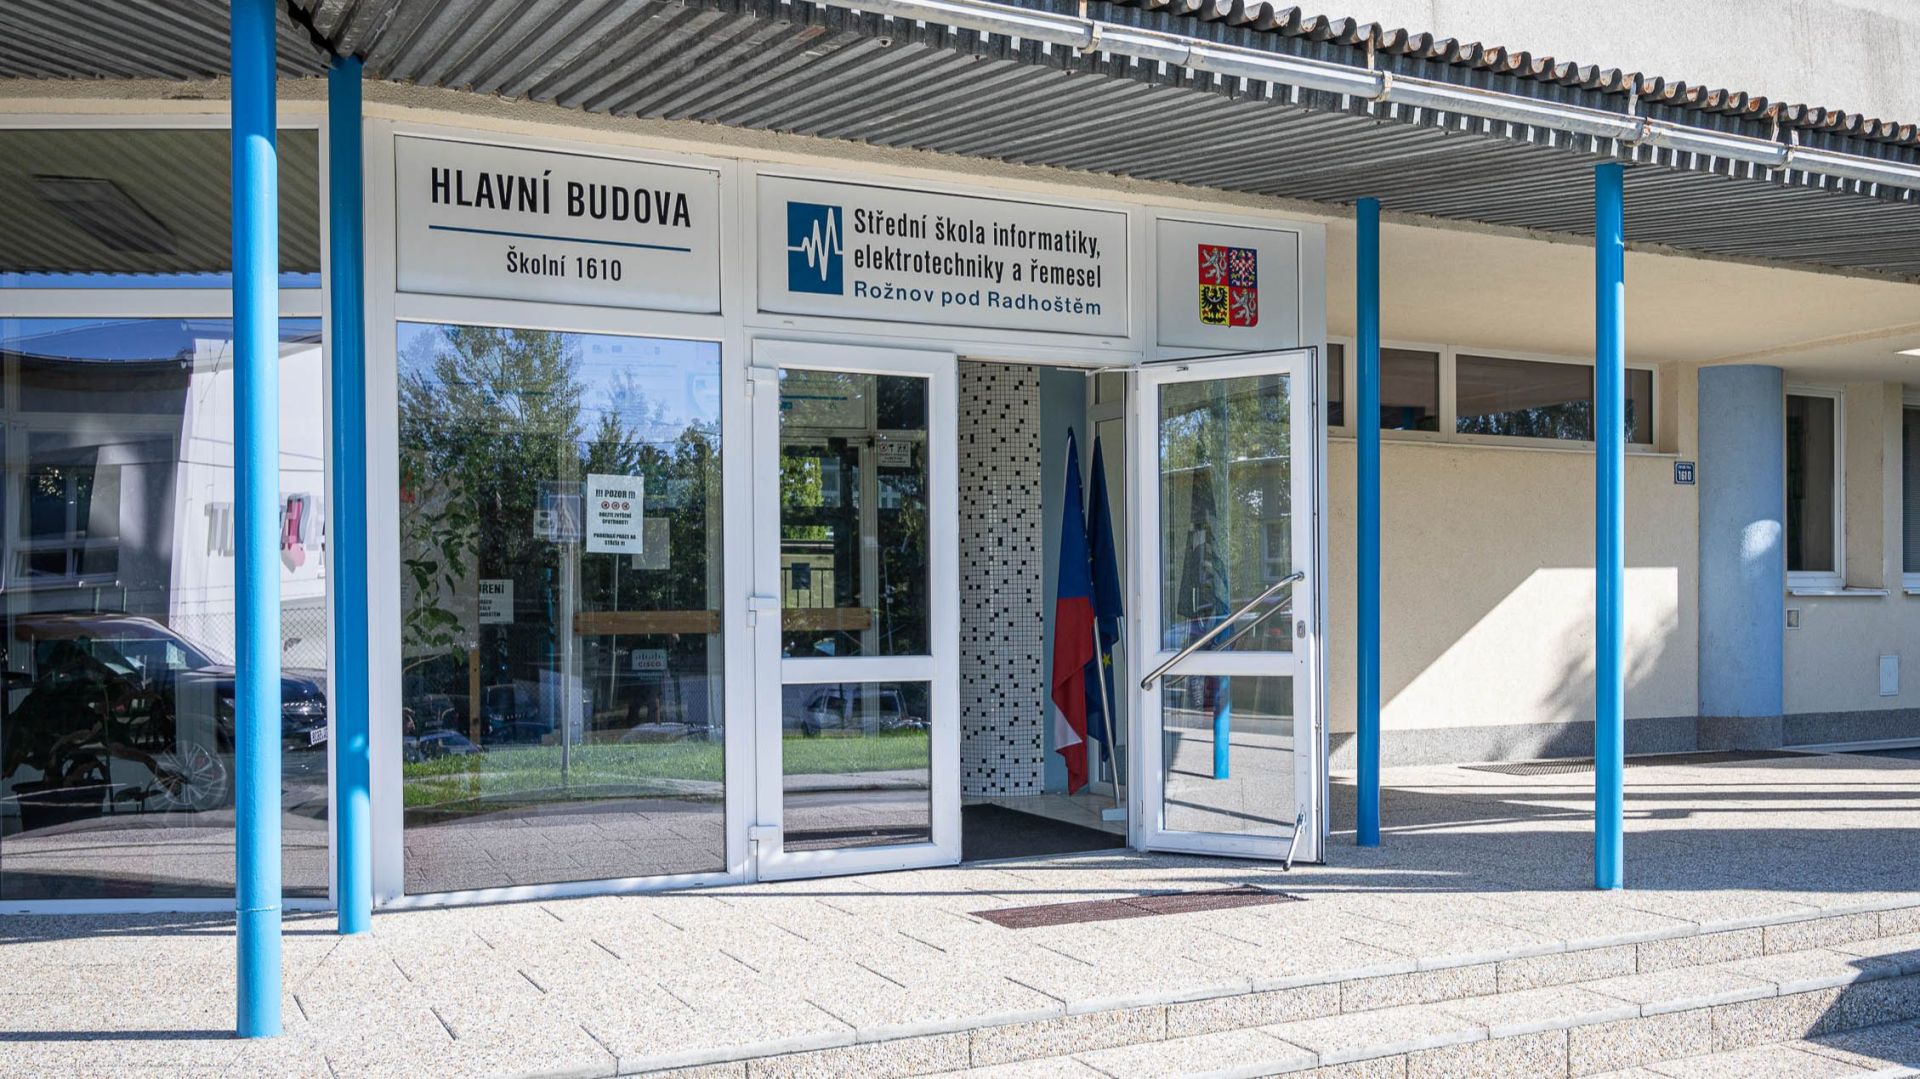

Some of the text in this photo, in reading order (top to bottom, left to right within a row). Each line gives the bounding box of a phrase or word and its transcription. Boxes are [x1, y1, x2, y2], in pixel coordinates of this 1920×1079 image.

[431, 167, 691, 228] HLAVNÍ BUDOVA
[854, 208, 1101, 259] Střední škola informatiky,
[506, 245, 622, 281] Školní 1610
[854, 246, 1101, 288] elektrotechniky a řemesel
[854, 281, 1101, 315] Rožnov pod Radhoštěm
[604, 489, 627, 498] POZOR
